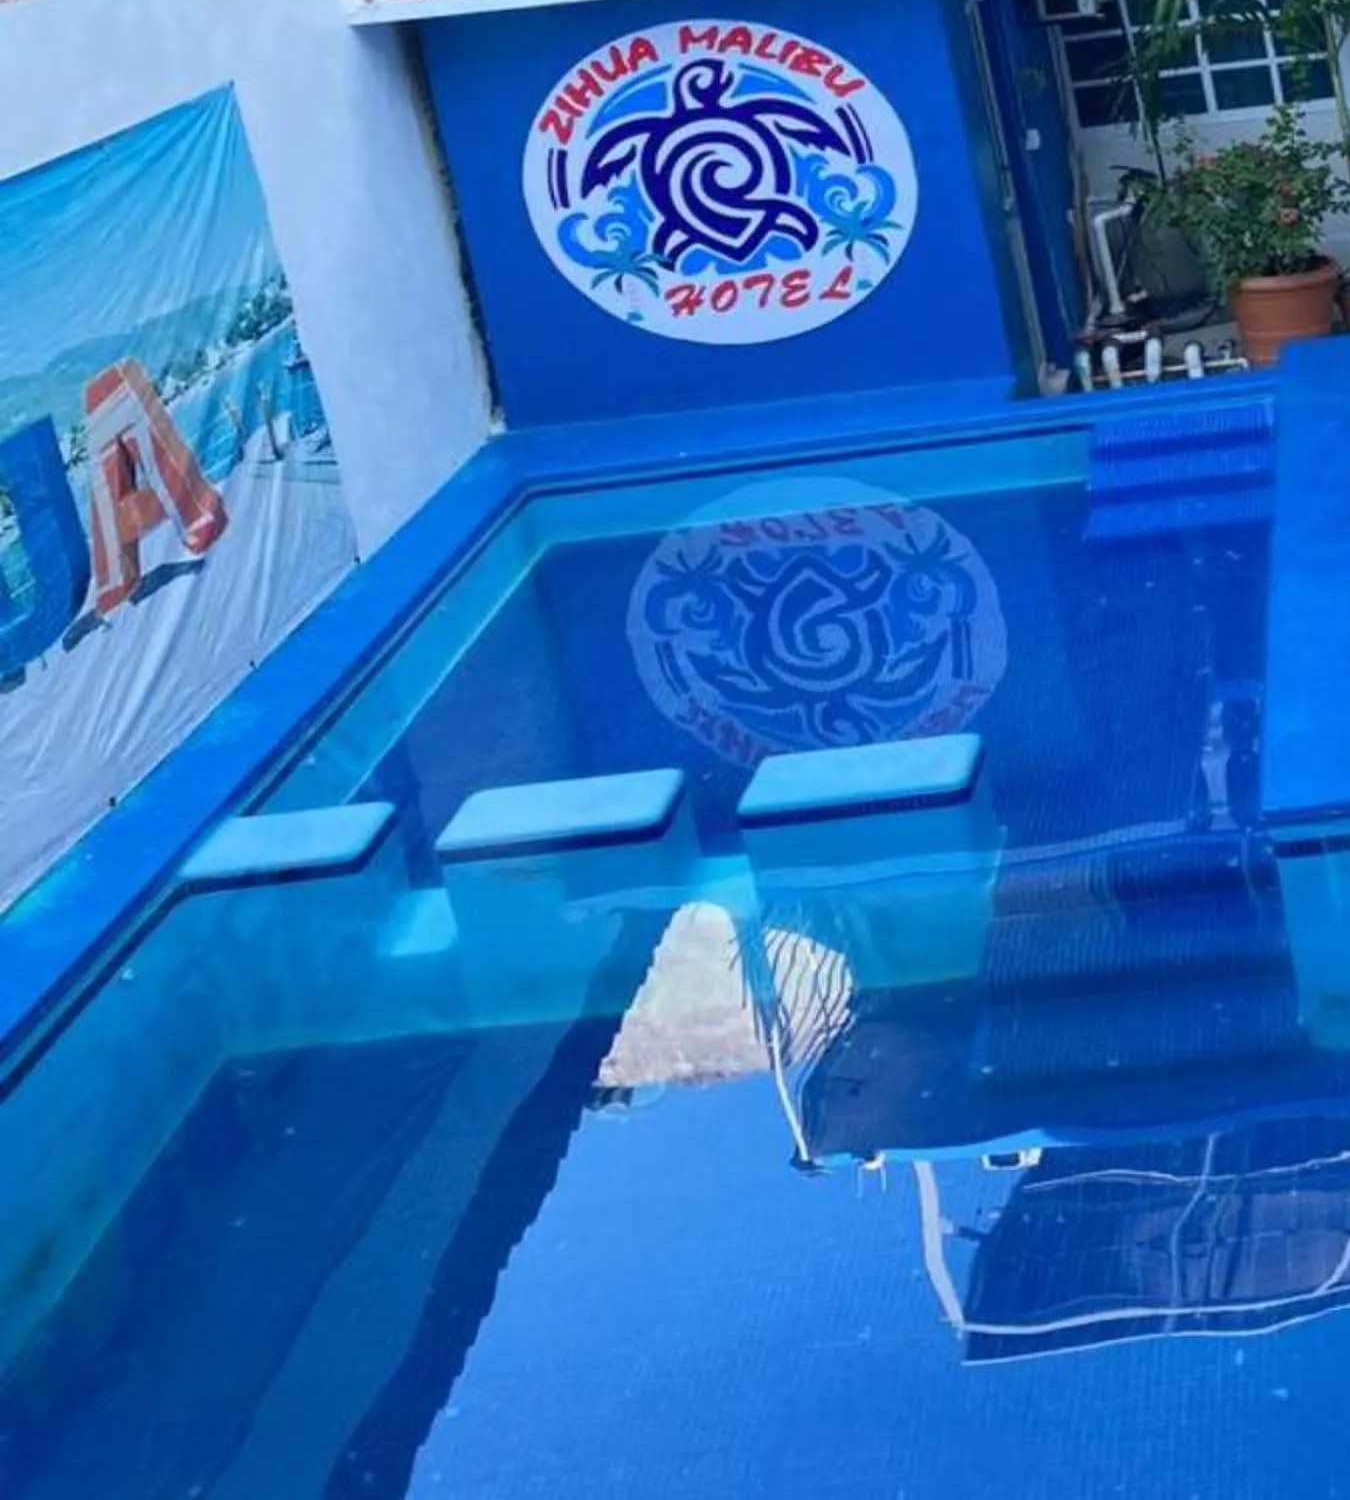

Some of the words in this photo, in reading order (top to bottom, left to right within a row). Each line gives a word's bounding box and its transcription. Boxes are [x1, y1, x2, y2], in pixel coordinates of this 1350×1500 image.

[539, 36, 660, 145] ZIHUA
[678, 25, 866, 98] MALIBU
[664, 266, 854, 316] HOTEL
